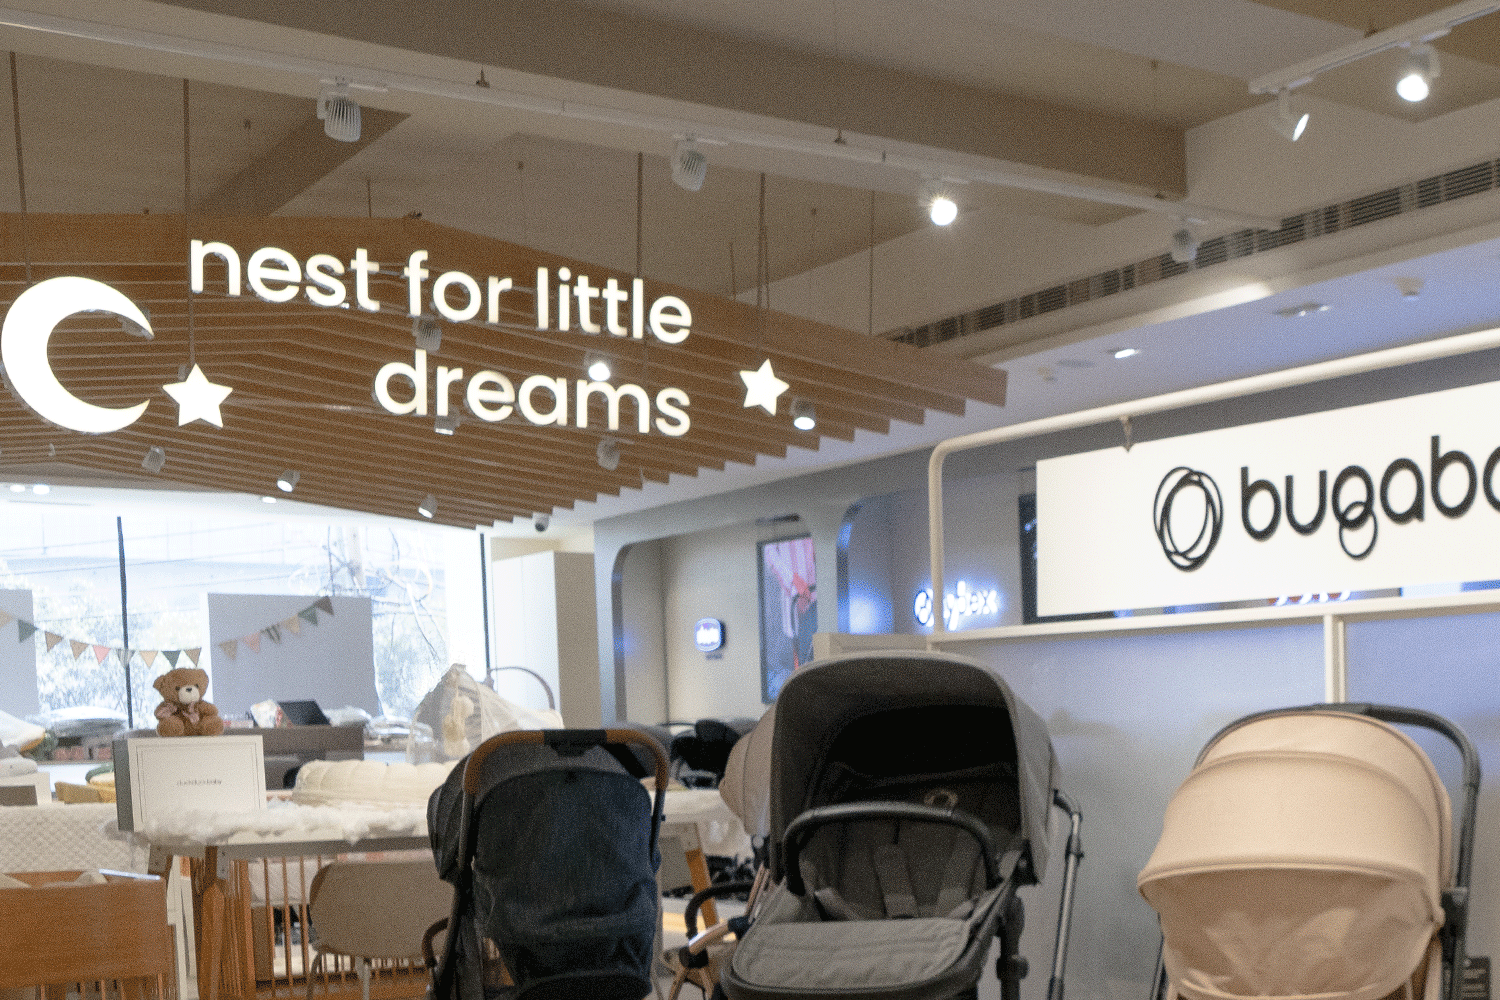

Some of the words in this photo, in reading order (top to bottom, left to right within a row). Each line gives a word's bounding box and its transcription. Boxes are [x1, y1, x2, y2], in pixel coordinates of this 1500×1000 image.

[190, 239, 380, 311] nest
[404, 250, 512, 323] for
[537, 266, 692, 344] little
[374, 349, 691, 436] dreams
